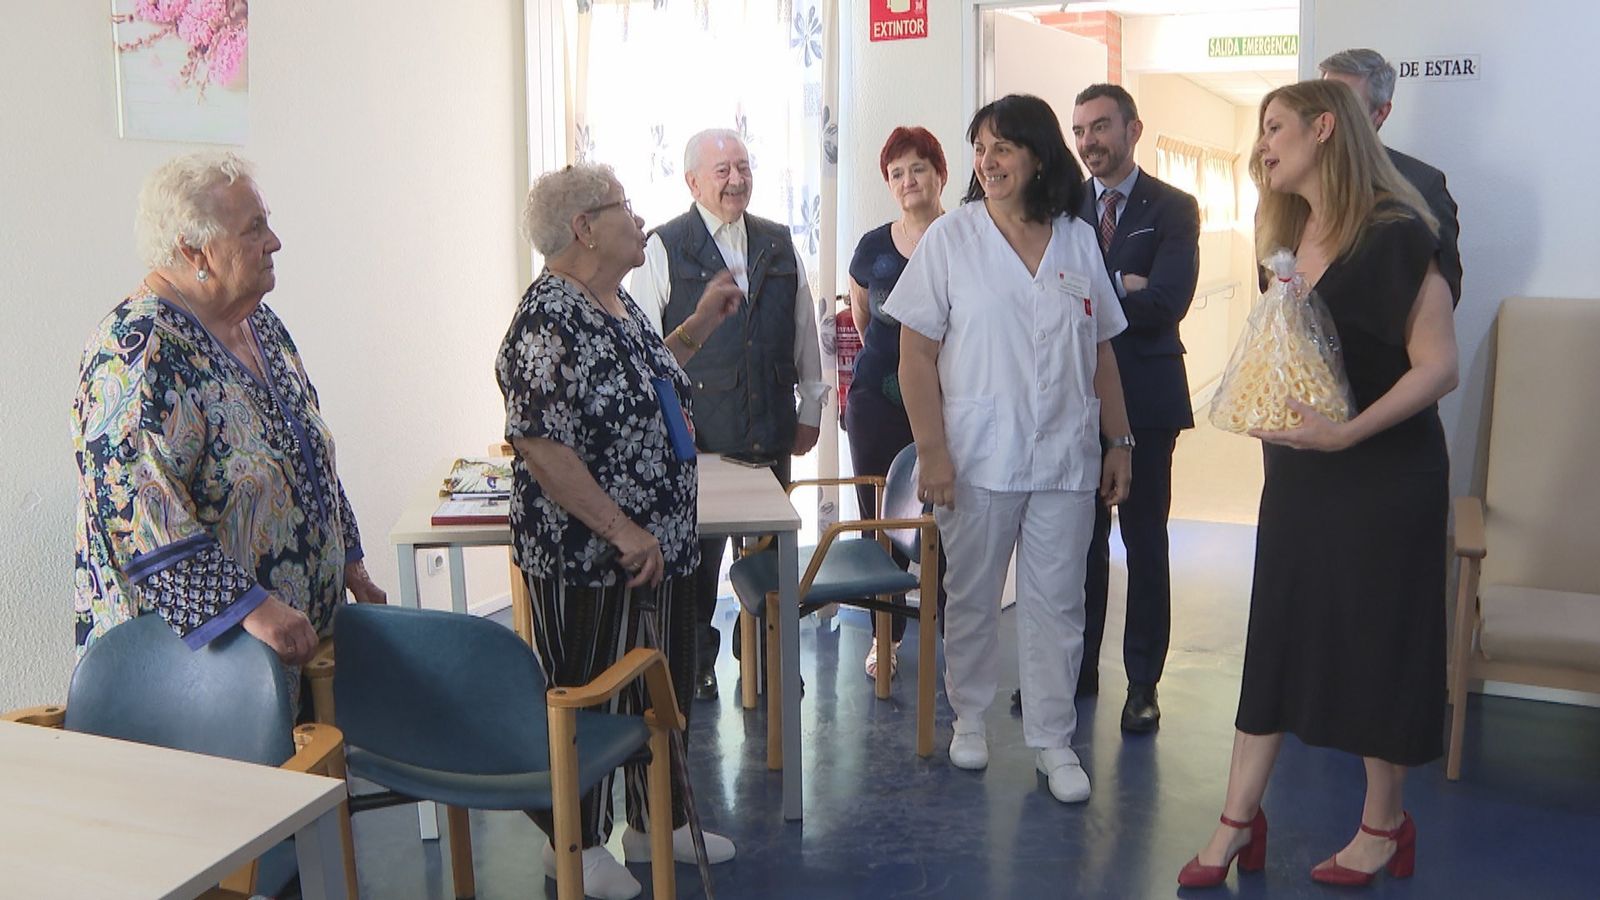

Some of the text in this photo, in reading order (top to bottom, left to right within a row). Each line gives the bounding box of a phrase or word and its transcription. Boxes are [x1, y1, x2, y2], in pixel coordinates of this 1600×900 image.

[874, 18, 925, 37] EXTINTOR
[1209, 36, 1297, 57] SALIDA EMERGENCIA
[1400, 62, 1419, 77] DE
